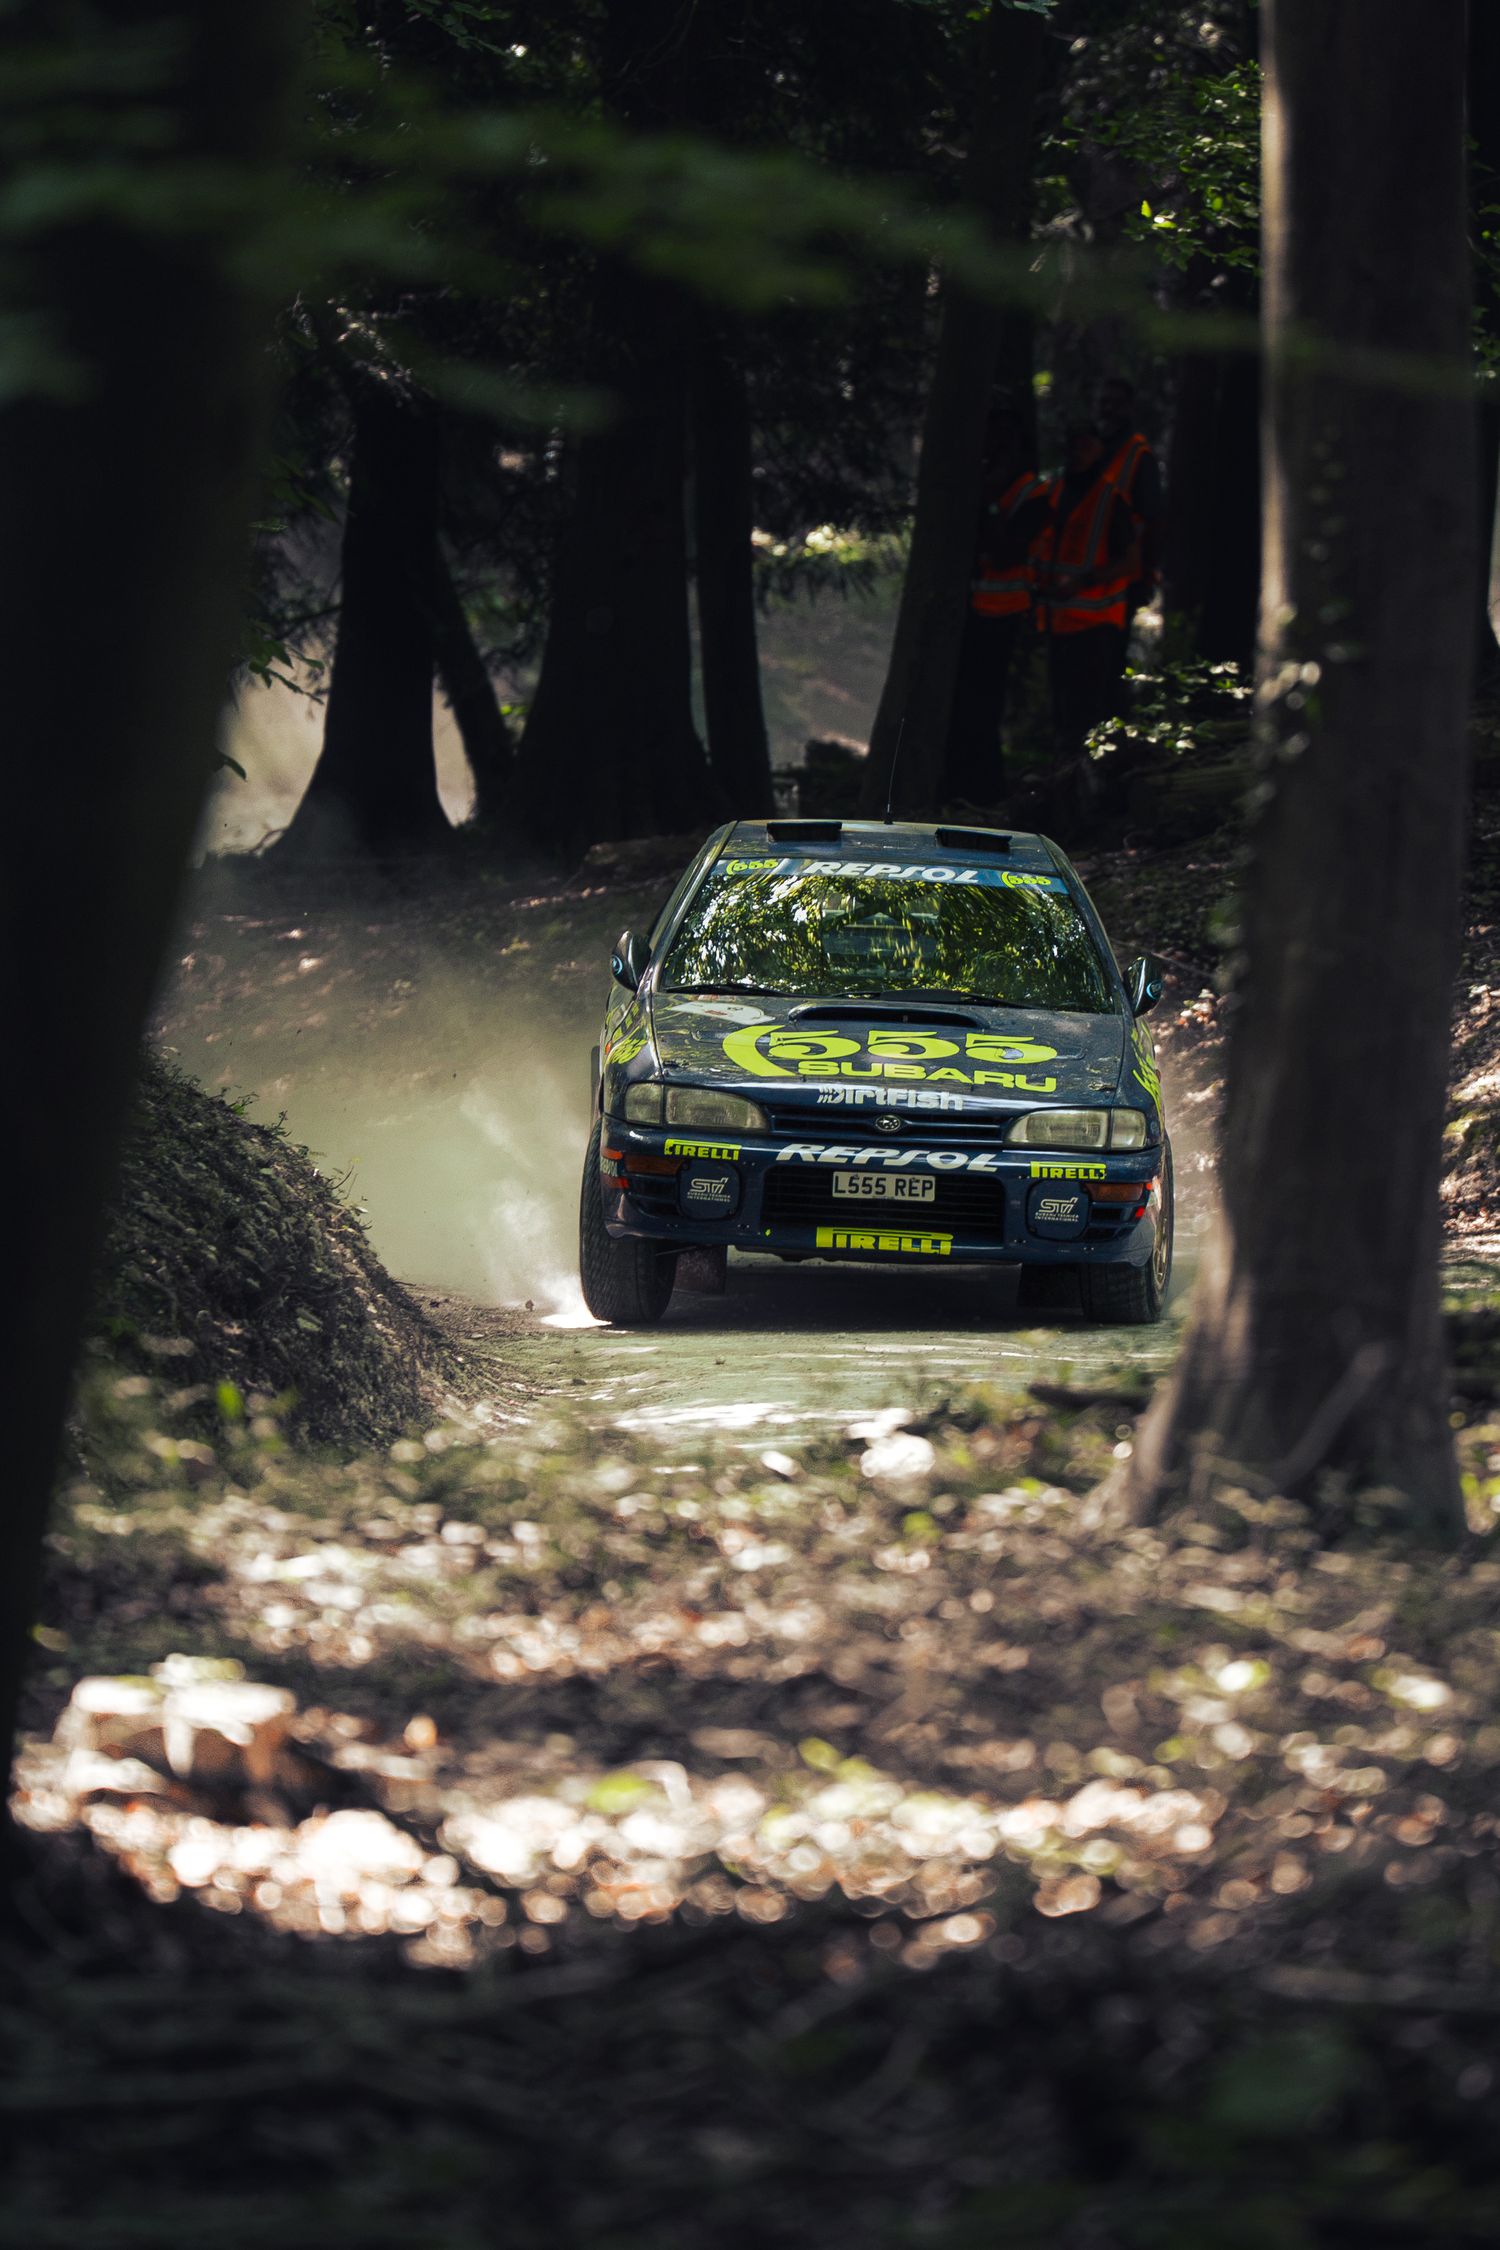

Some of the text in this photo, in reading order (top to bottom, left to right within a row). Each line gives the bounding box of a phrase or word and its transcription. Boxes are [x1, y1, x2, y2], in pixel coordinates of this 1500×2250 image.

[803, 860, 981, 884] REPSOL
[1005, 873, 1052, 887] 555
[767, 1028, 1058, 1065] 555
[797, 1060, 1057, 1093] SUBARU
[664, 1138, 742, 1161] PIRELLI
[775, 1143, 998, 1173] REPSOL
[1030, 1161, 1106, 1180] PIRELLI
[834, 1175, 934, 1198] L555 REP
[815, 1226, 954, 1256] PIRELLI
